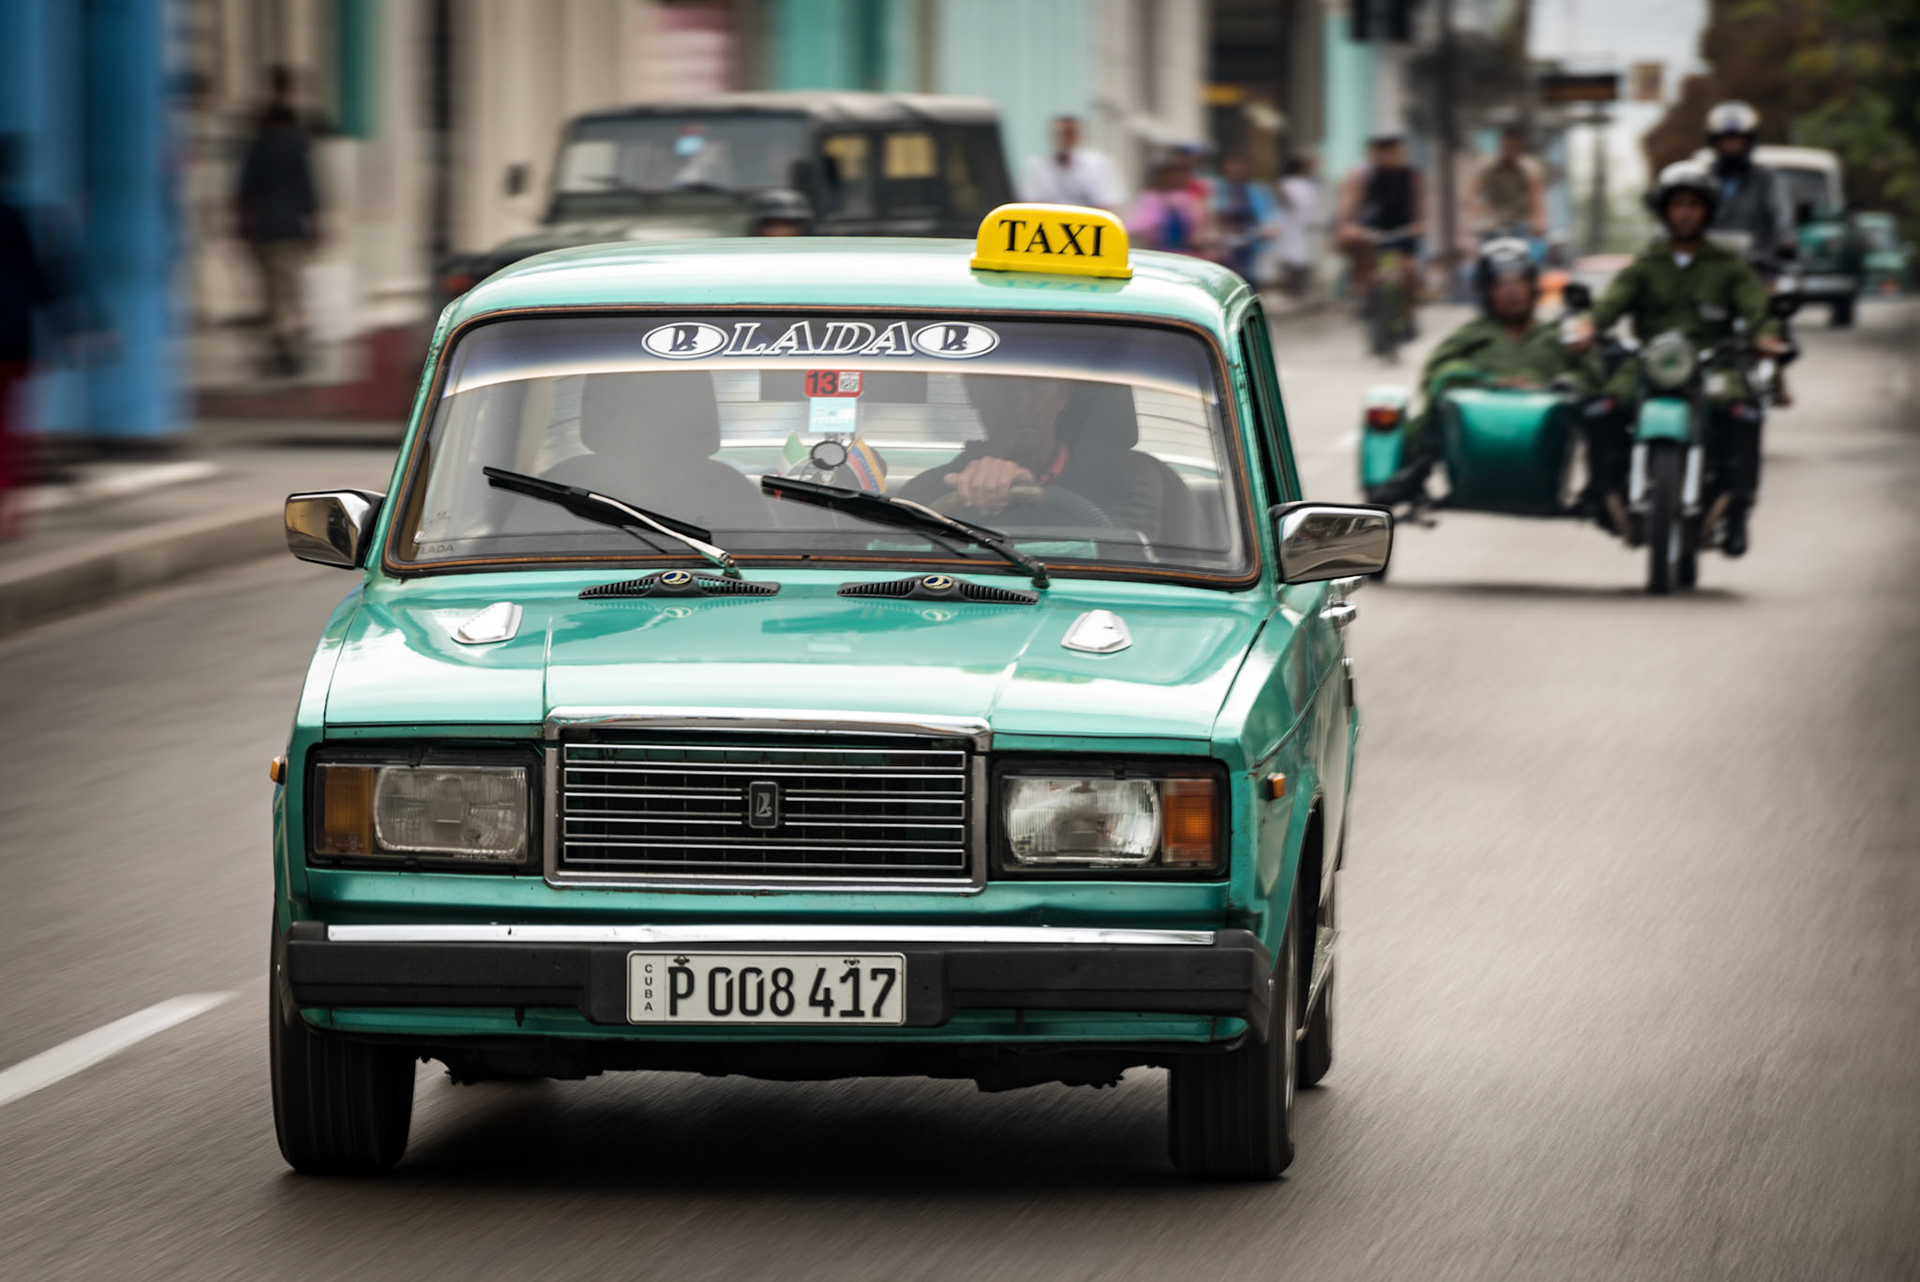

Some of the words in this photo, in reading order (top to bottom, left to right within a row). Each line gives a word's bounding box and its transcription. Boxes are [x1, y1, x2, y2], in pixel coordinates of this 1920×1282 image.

[999, 219, 1105, 256] TAXI
[722, 320, 915, 356] LADA
[807, 372, 837, 395] 13
[420, 544, 454, 554] LADA
[644, 964, 653, 1012] CUBA
[668, 966, 695, 1016] P
[708, 966, 795, 1017] 008
[808, 967, 897, 1017] 417
